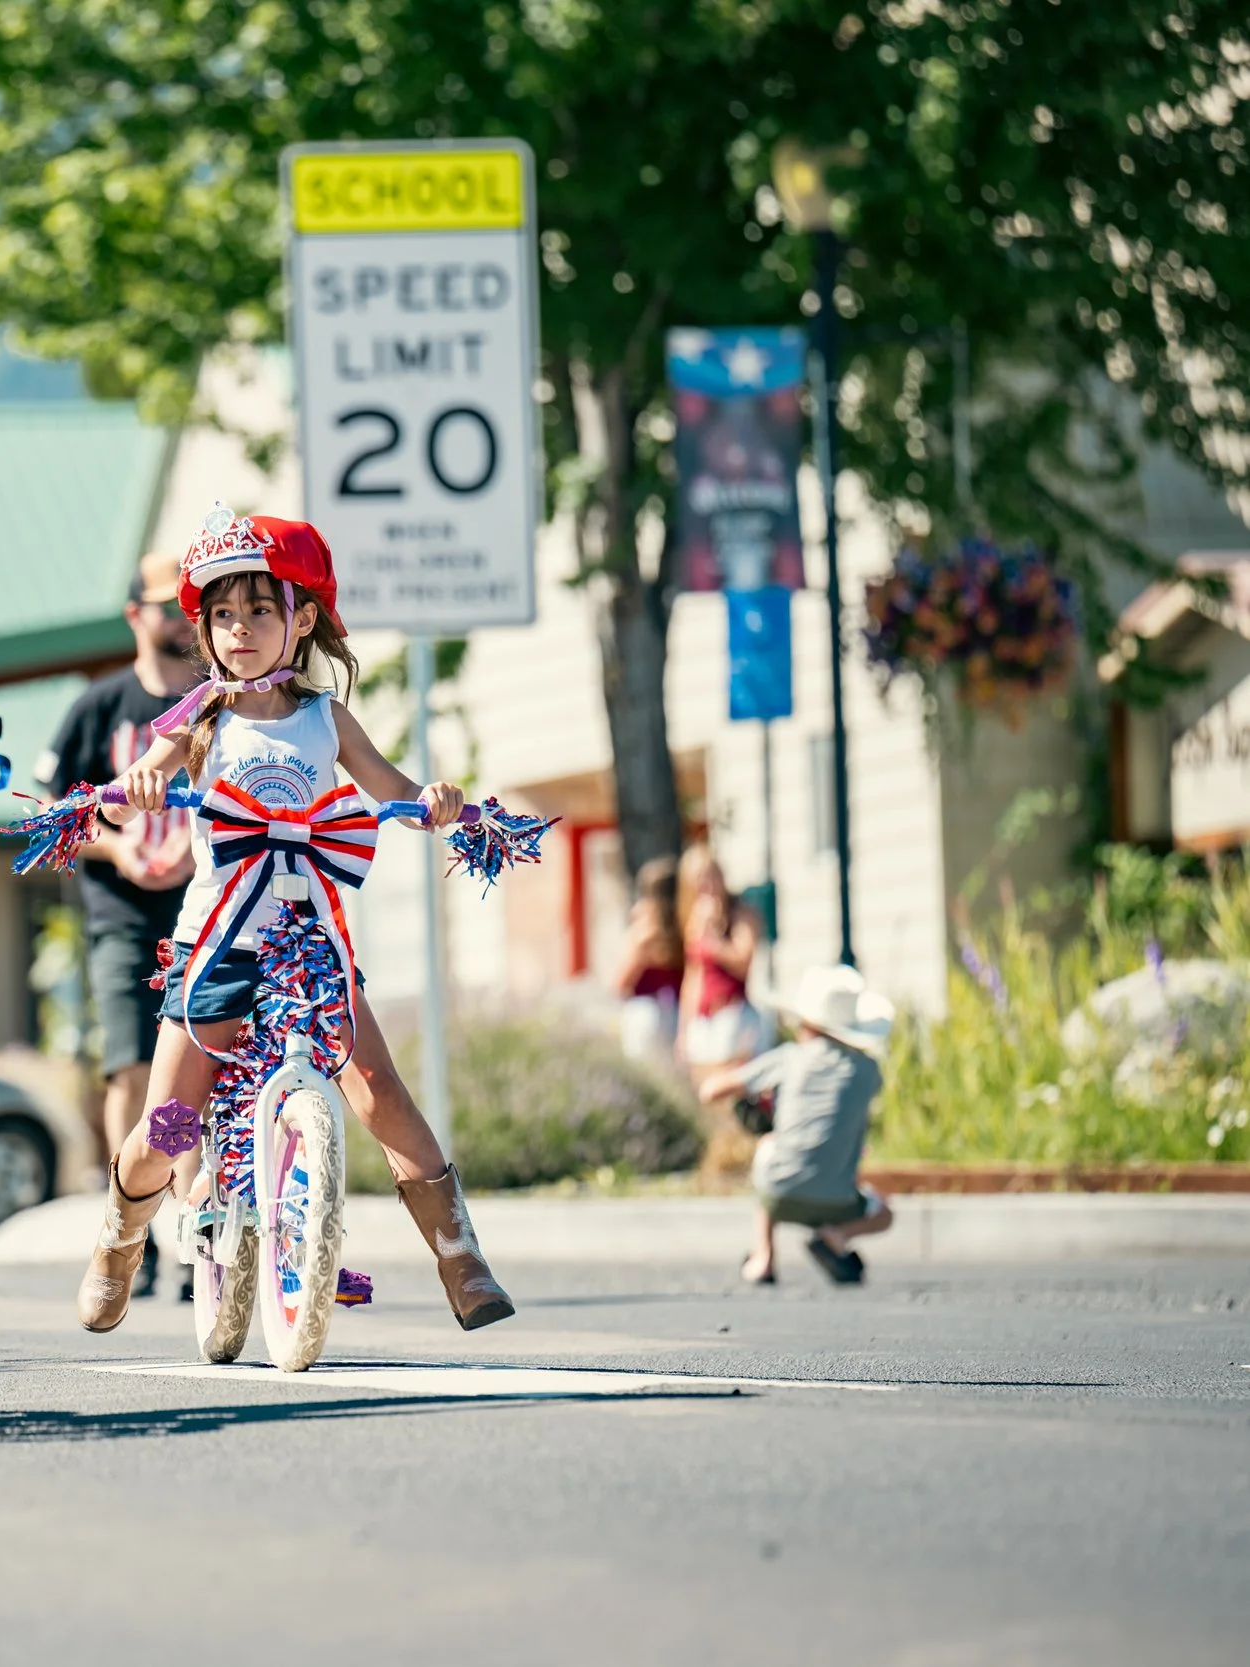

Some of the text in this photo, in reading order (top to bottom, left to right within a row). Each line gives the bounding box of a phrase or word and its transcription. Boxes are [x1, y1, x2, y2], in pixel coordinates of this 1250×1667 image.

[305, 166, 514, 217] SCHOOL
[312, 262, 511, 315] SPEED
[333, 332, 485, 382] LIMIT
[334, 405, 499, 498] 20
[267, 751, 278, 764] to
[283, 753, 318, 785] sparkle
